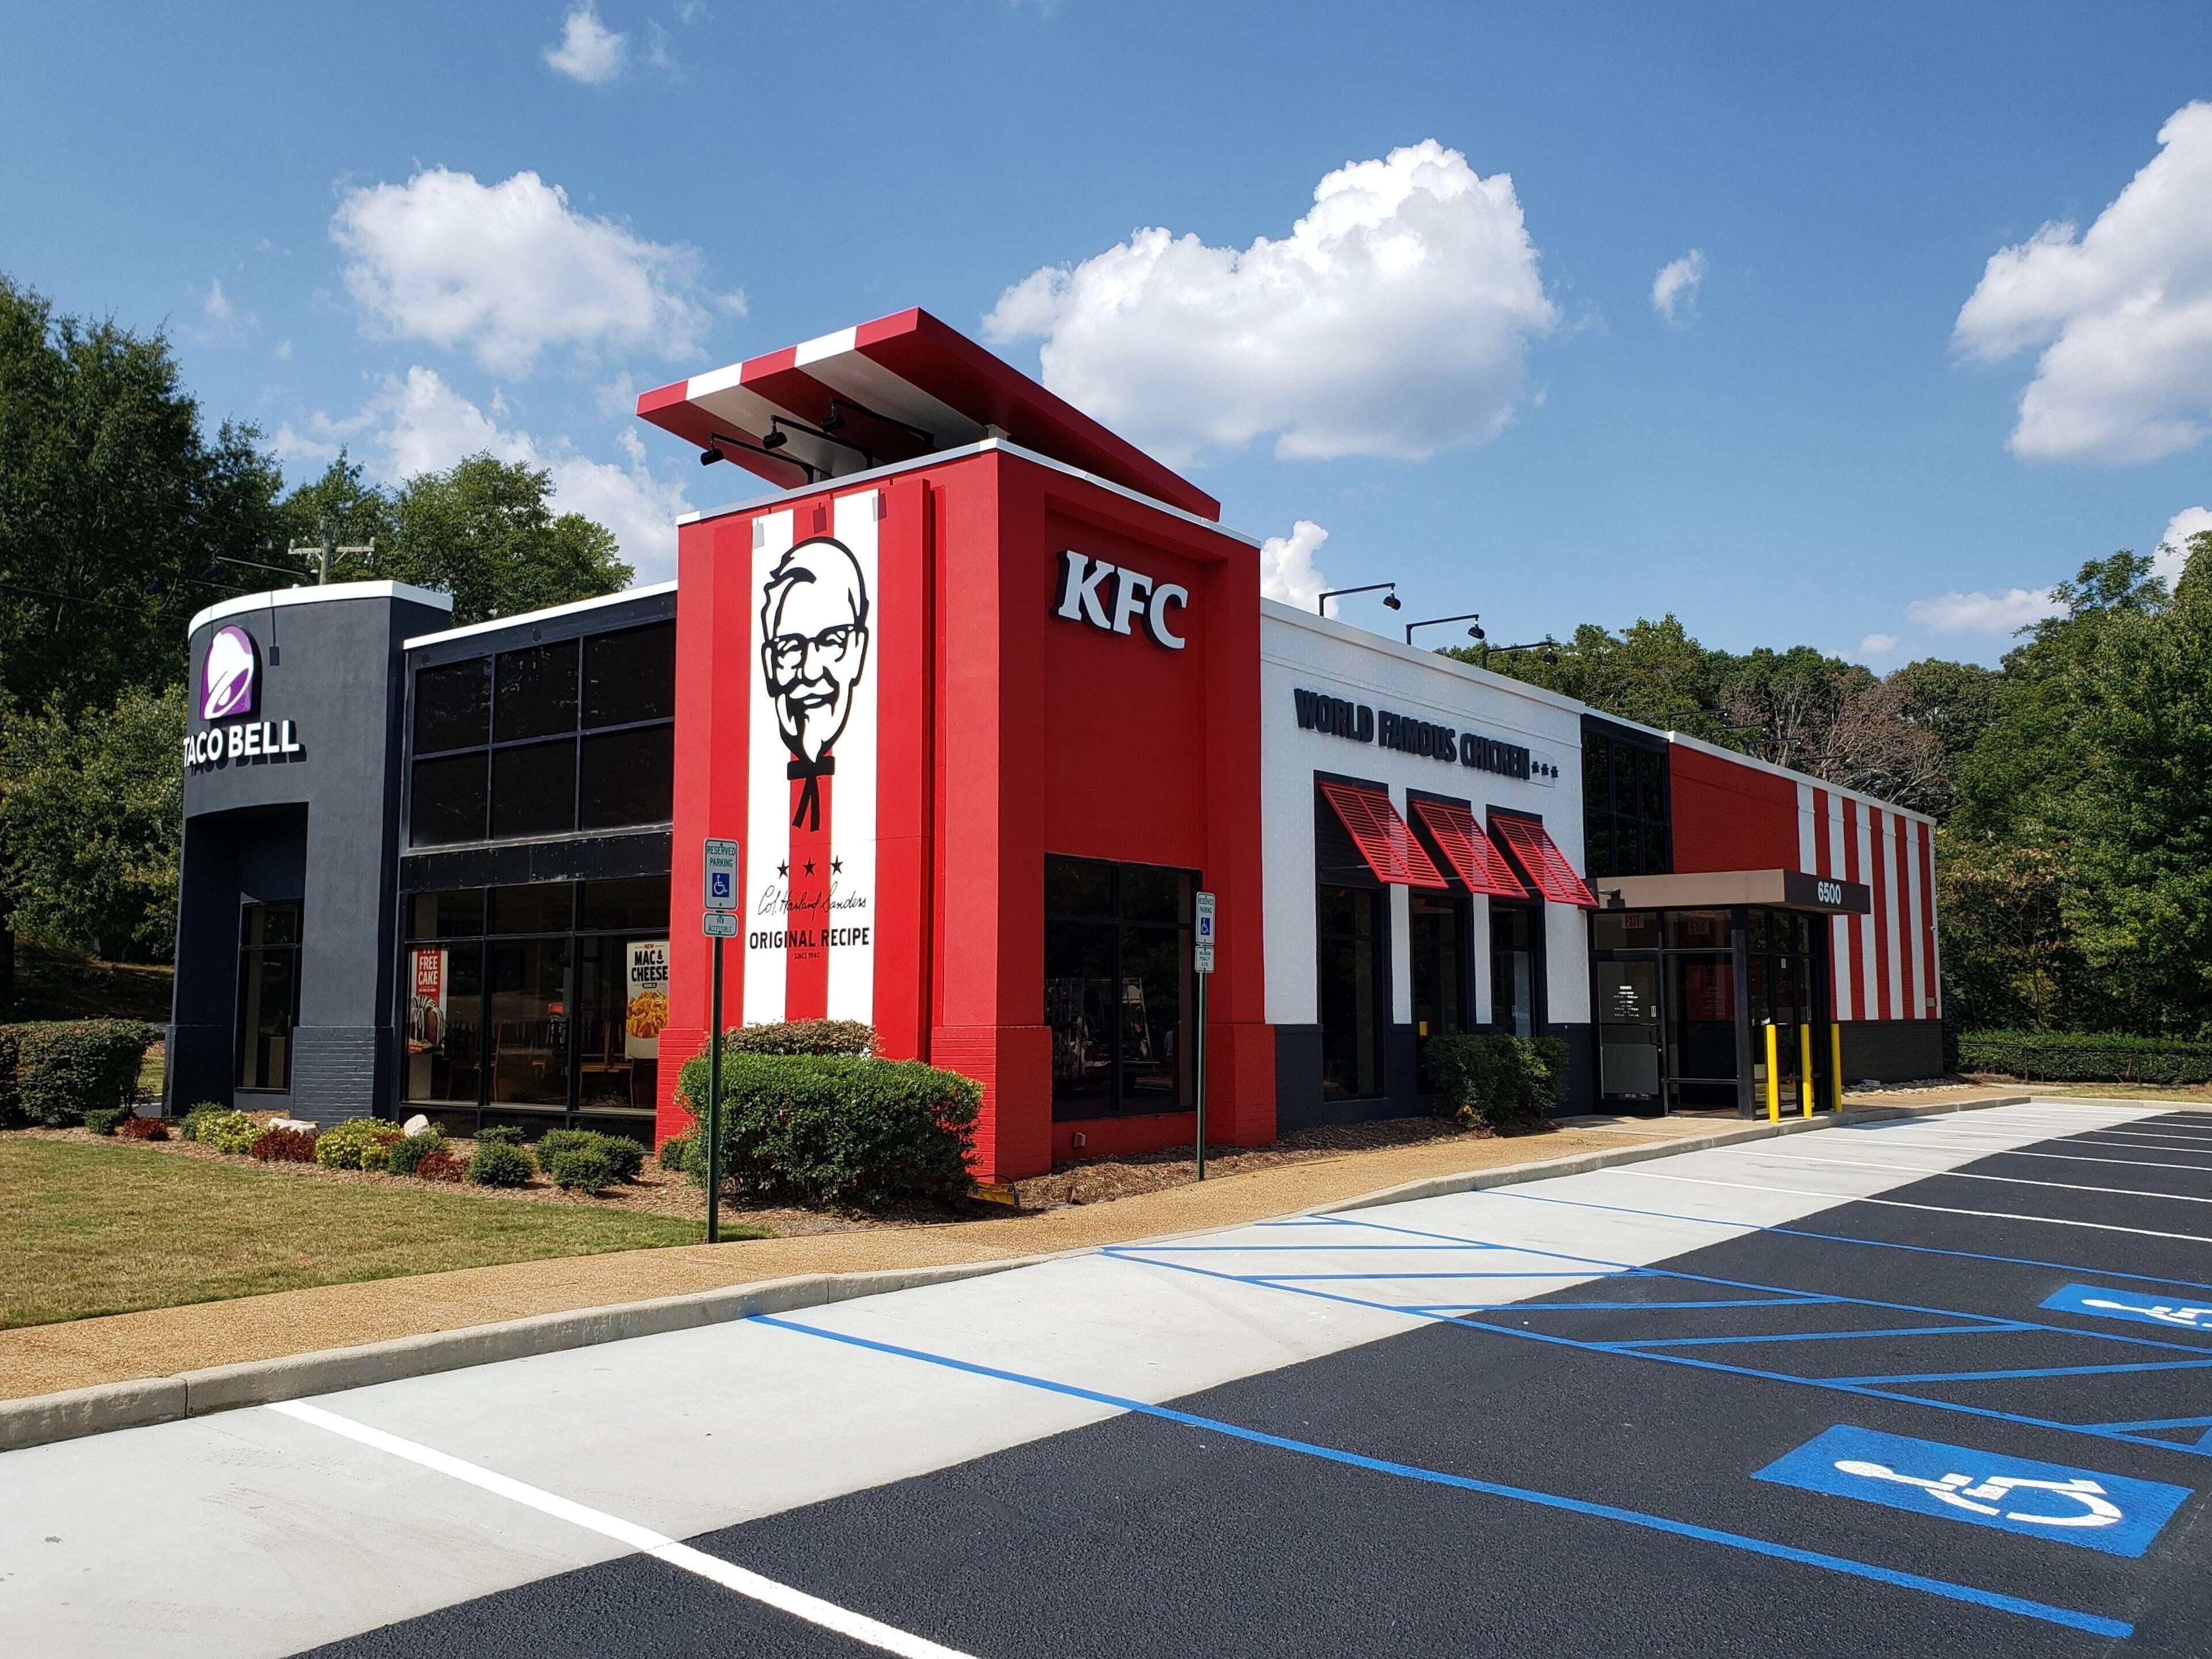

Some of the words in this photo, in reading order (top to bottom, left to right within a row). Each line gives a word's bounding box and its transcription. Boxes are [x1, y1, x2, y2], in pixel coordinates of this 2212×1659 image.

[1058, 550, 1188, 649] KFC
[1293, 688, 1374, 743] WORLD
[1378, 710, 1457, 763] FAMOUS
[1460, 733, 1530, 781] CHICKEN
[183, 728, 223, 768] TACO
[228, 720, 299, 758] BELL
[707, 845, 736, 856] RESERVED
[709, 857, 733, 867] PARKING
[1818, 881, 1841, 905] 6500
[708, 924, 732, 933] ACCESSIBLE
[1625, 915, 1640, 928] EXIT
[750, 929, 816, 949] ORIGINAL
[821, 927, 869, 947] RECIPE
[419, 956, 438, 971] FREE
[634, 950, 656, 966] MAC
[657, 949, 663, 960] &
[418, 971, 439, 985] CAKE
[631, 965, 668, 982] CHEESE
